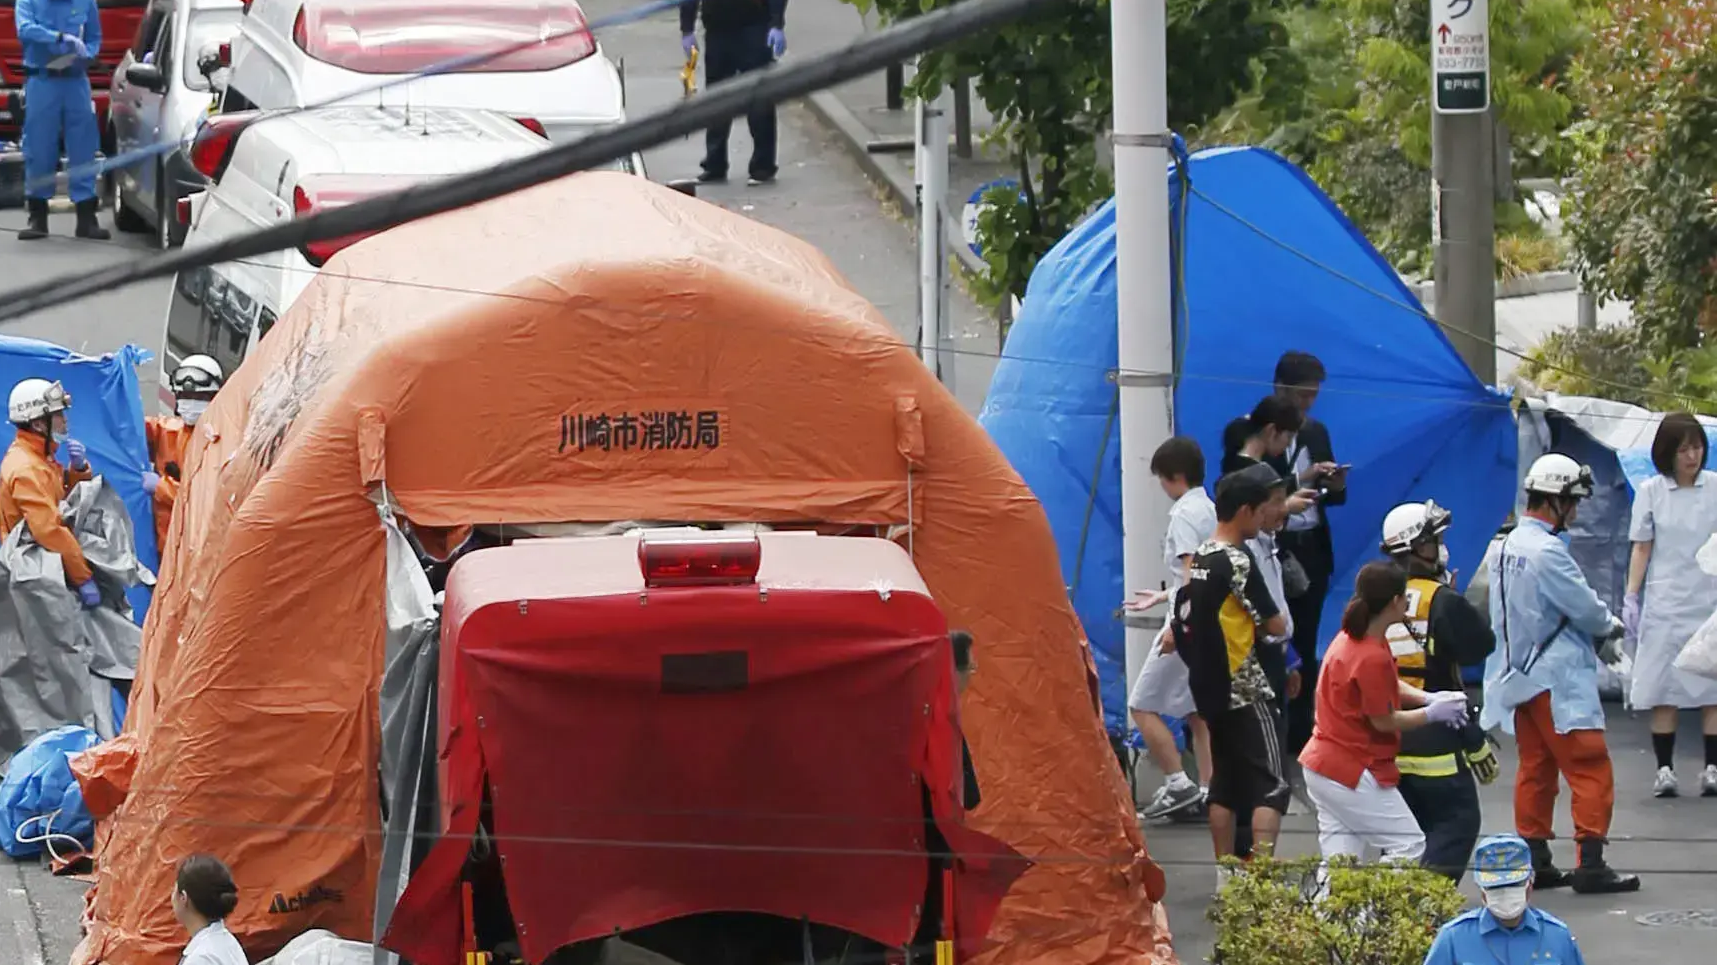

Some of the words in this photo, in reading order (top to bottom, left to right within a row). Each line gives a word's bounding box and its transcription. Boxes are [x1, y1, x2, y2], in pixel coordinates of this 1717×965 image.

[558, 410, 720, 453] 川崎市消防局
